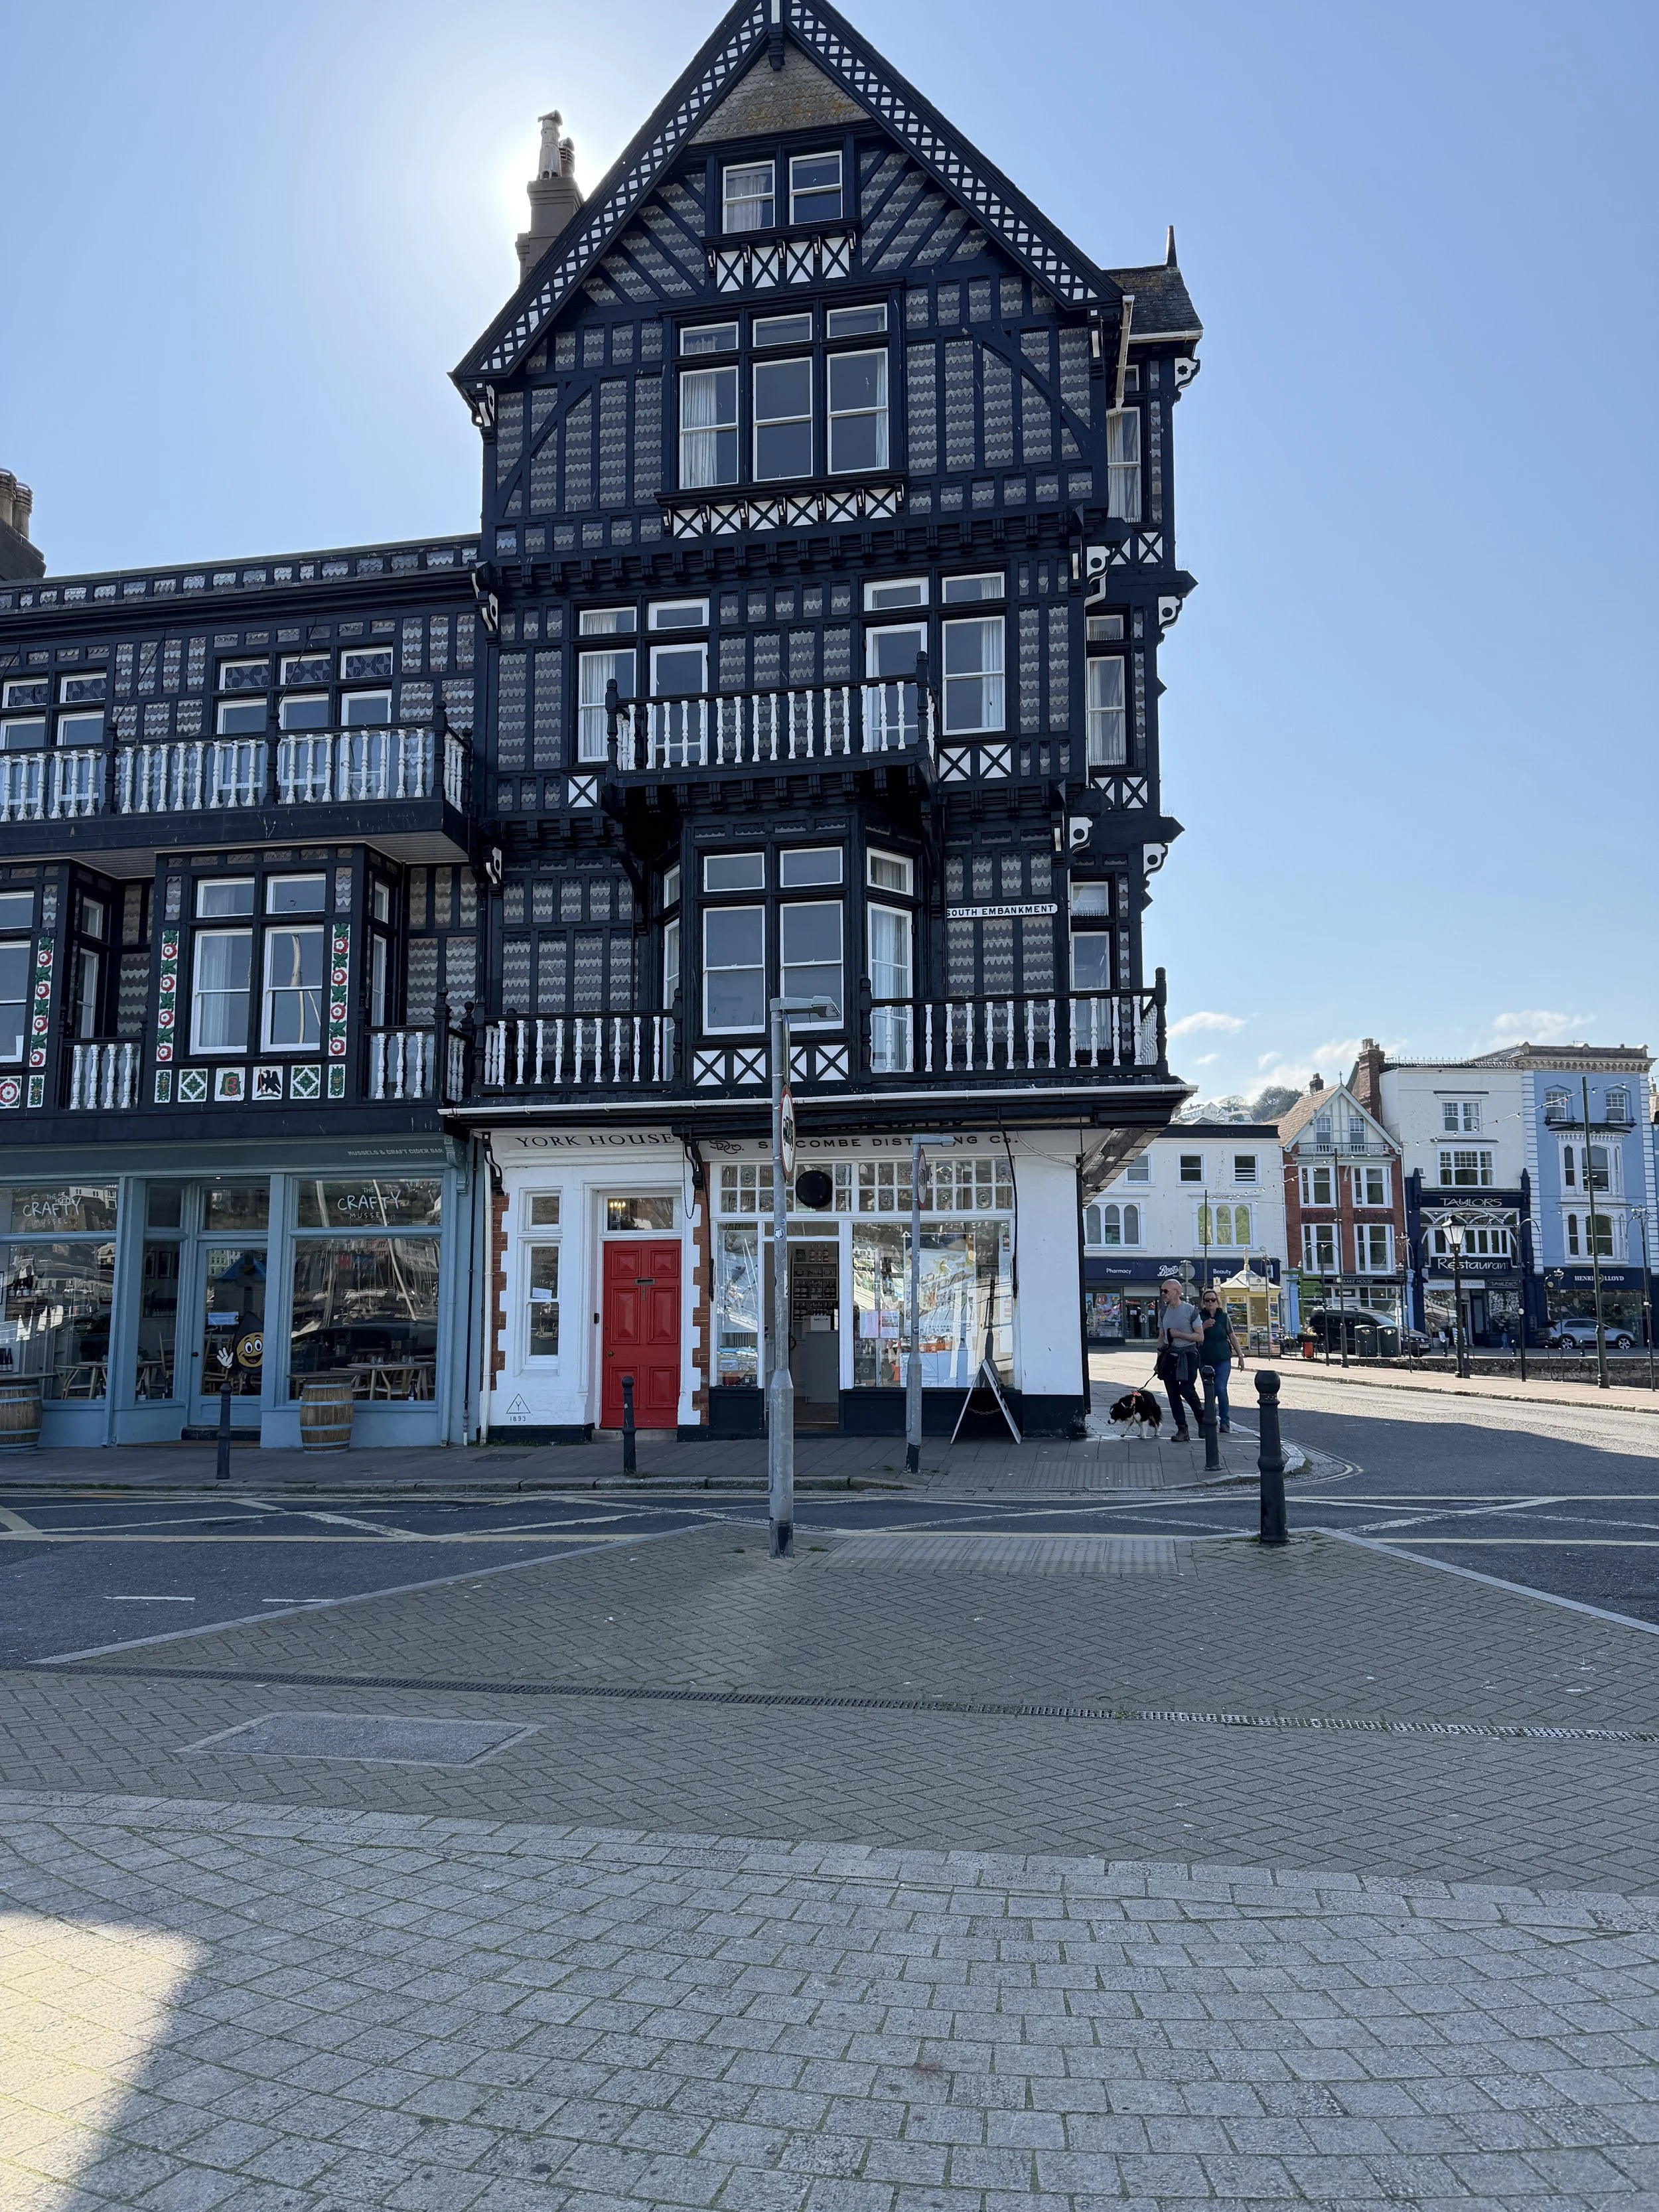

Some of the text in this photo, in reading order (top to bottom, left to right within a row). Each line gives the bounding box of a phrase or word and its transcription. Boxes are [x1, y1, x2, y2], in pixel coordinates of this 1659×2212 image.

[947, 905, 1054, 917] SOUTH EMBANKMENT
[515, 1133, 676, 1147] YORK HOUSE
[758, 1138, 861, 1149] SCOMBE
[872, 1136, 978, 1147] DISTNG
[23, 1197, 81, 1217] CRAFTY
[338, 1190, 401, 1211] CRAFTY
[1439, 1197, 1503, 1208] TAYLORS
